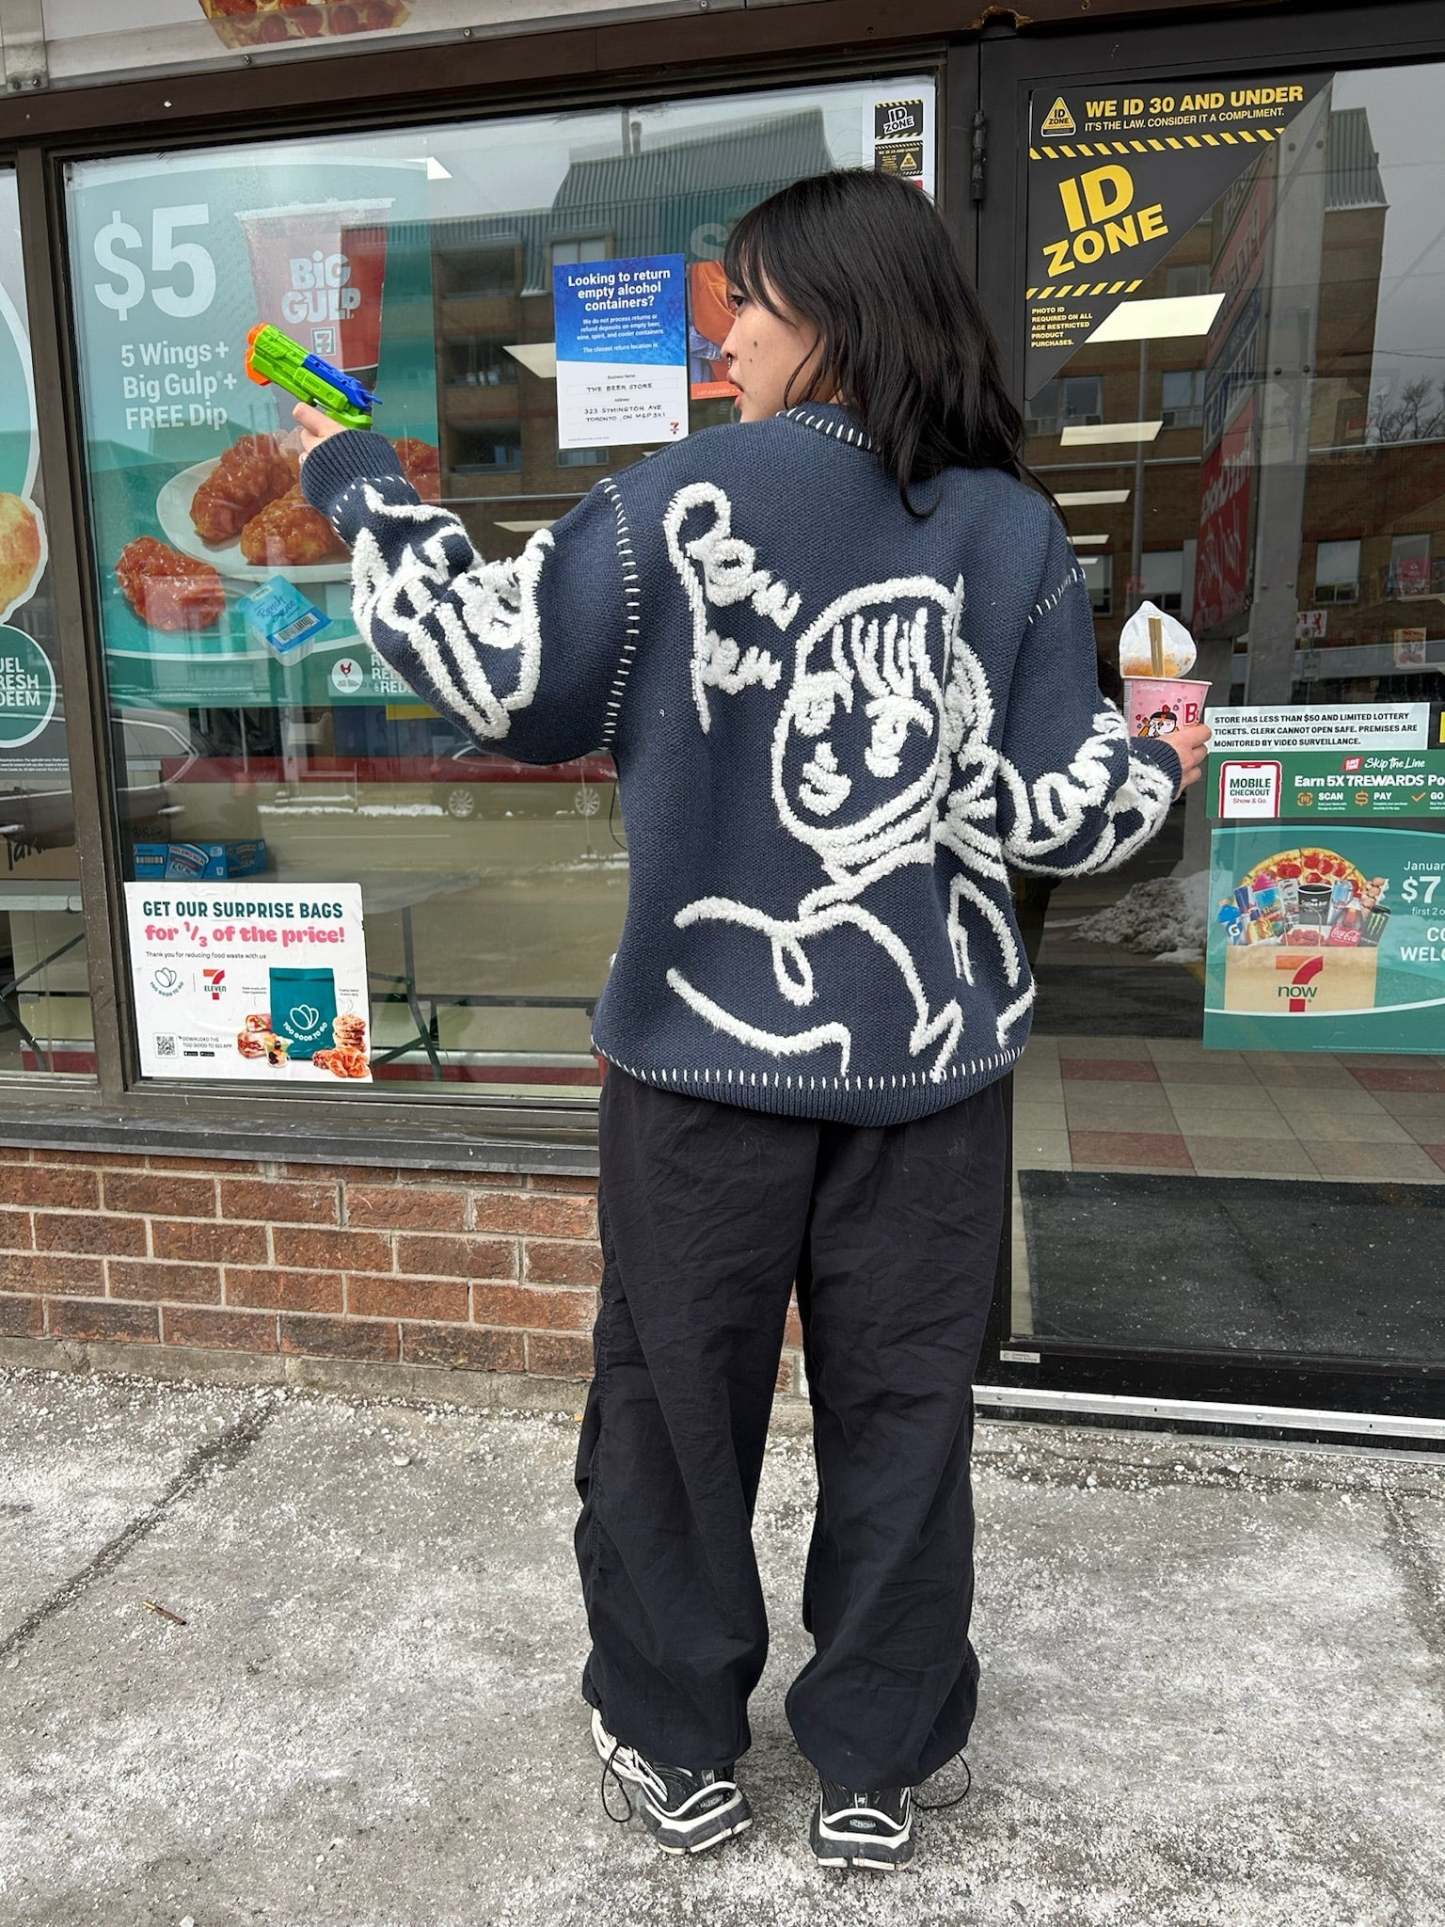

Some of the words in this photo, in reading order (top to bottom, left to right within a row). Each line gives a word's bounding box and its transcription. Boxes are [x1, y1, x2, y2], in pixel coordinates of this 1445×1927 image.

[1086, 100, 1117, 118] WE
[1123, 98, 1144, 116] ID
[1149, 96, 1176, 114] 30
[1180, 93, 1225, 112] AND
[1230, 86, 1304, 107] UNDER
[889, 107, 907, 121] ID
[1054, 109, 1066, 118] ID
[1085, 121, 1102, 132] IT'S
[1103, 120, 1121, 130] THE
[1123, 119, 1146, 129] LAW.
[1147, 114, 1197, 128] CONSIDER
[1198, 114, 1208, 123] IT
[1209, 113, 1217, 122] A
[1219, 107, 1285, 121] COMPLIMENT.
[884, 117, 914, 133] ZONE
[1058, 164, 1135, 233] ID
[1043, 204, 1169, 278] ZONE
[94, 203, 216, 321] $5
[568, 273, 615, 287] Looking
[618, 272, 631, 282] to
[633, 270, 671, 281] return
[578, 287, 615, 300] empty
[617, 281, 661, 296] alcohol
[281, 287, 361, 324] GULP
[585, 296, 655, 311] containers?
[1032, 315, 1067, 323] REQUIRED
[1047, 322, 1090, 330] RESTRICTED
[121, 344, 135, 368] 5
[123, 373, 161, 403] Big
[125, 405, 185, 430] FREE
[189, 401, 228, 431] Dip
[1214, 716, 1241, 724] STORE
[1260, 715, 1280, 723] LESS
[1303, 714, 1320, 723] $50
[1340, 713, 1372, 721] LIMITED
[1373, 712, 1410, 720] LOTTERY
[1250, 727, 1276, 735] CLERK
[1358, 724, 1400, 732] PREMISES
[1401, 724, 1418, 732] ARE
[1214, 739, 1260, 747] MONITORED
[1299, 737, 1361, 746] SURVEILLANCE.
[1364, 757, 1388, 772] Skip
[1388, 756, 1404, 770] The
[1404, 757, 1425, 769] Line
[1229, 778, 1271, 788] MOBILE
[1294, 775, 1325, 787] Earn
[1326, 775, 1345, 787] 5X
[1346, 774, 1425, 787] 7REWARDS
[1229, 788, 1270, 797] CHECKOUT
[1318, 792, 1343, 801] SCAN
[1373, 792, 1392, 800] PAY
[1430, 791, 1444, 800] GO
[1401, 876, 1441, 904] $7
[143, 901, 171, 917] GET
[176, 901, 208, 917] OUR
[213, 902, 294, 918] SURPRISE
[299, 902, 343, 918] BAGS
[1412, 907, 1430, 916] first
[1432, 907, 1438, 916] 2
[145, 924, 179, 941] for
[212, 926, 236, 942] of
[239, 926, 277, 942] the
[281, 926, 345, 948] price!
[185, 951, 211, 959] reducing
[1278, 986, 1318, 998] now
